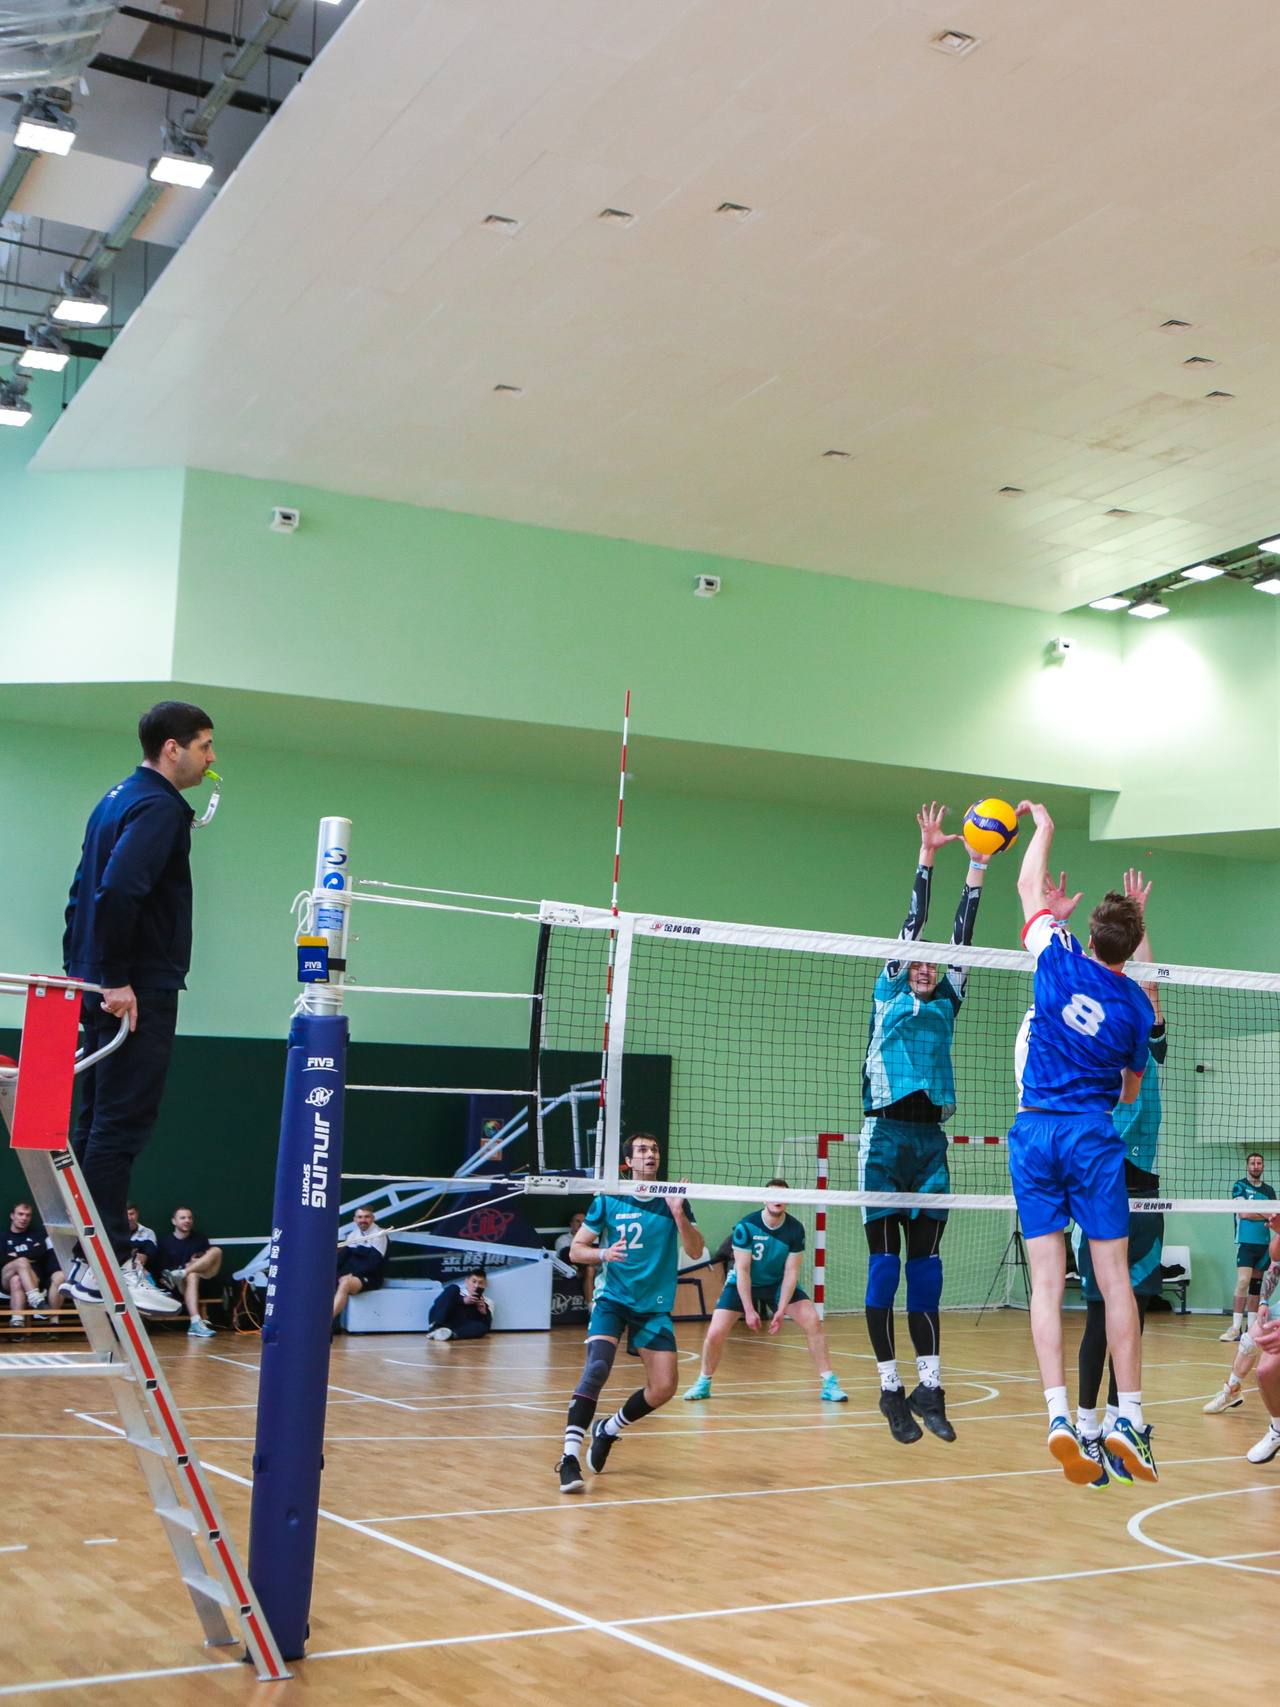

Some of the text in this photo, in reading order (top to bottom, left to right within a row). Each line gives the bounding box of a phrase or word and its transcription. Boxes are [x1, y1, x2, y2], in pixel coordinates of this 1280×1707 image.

[304, 961, 322, 969] FIVB
[1157, 968, 1170, 976] FIVB
[1062, 993, 1106, 1037] 8
[307, 1057, 334, 1067] FIVB
[301, 1164, 311, 1206] SPORTS
[615, 1222, 644, 1250] 12
[752, 1242, 765, 1261] 3
